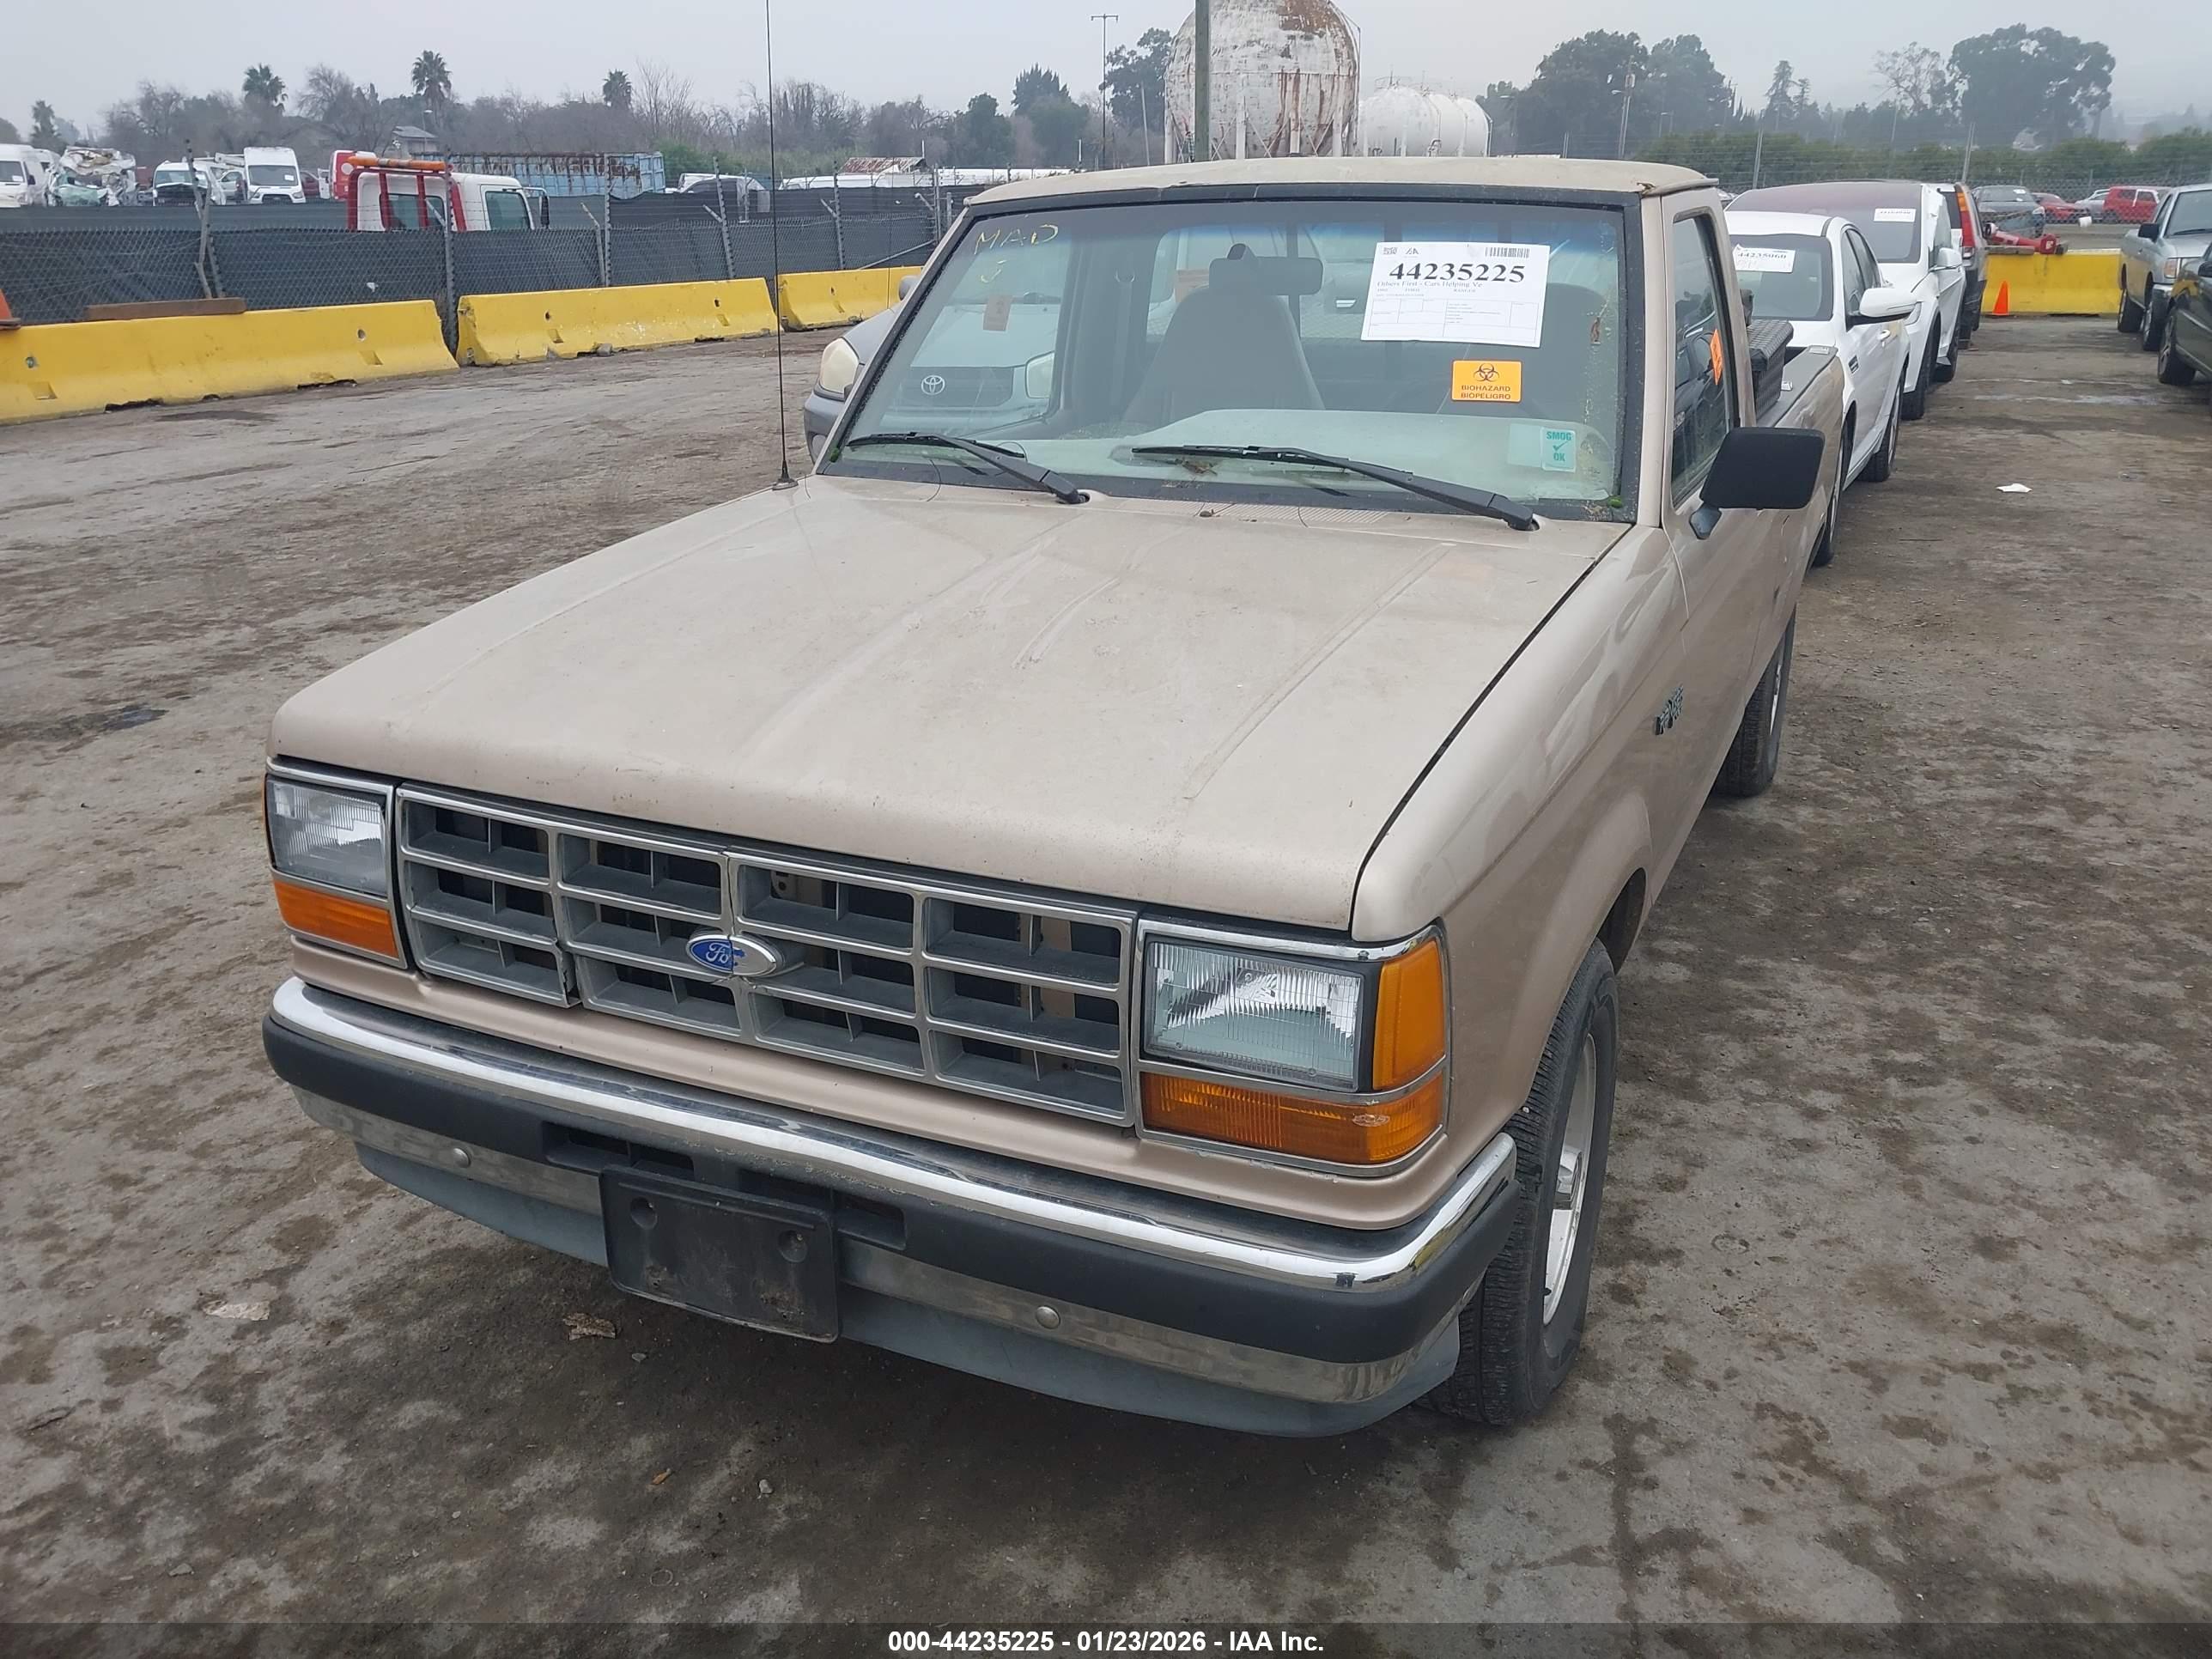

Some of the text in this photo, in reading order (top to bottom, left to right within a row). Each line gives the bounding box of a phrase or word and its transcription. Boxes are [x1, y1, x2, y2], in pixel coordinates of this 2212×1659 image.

[1389, 263, 1526, 283] 44235225
[1461, 392, 1511, 400] BIOPELIGRO
[1547, 430, 1572, 441] SMOG
[1553, 452, 1566, 462] OK
